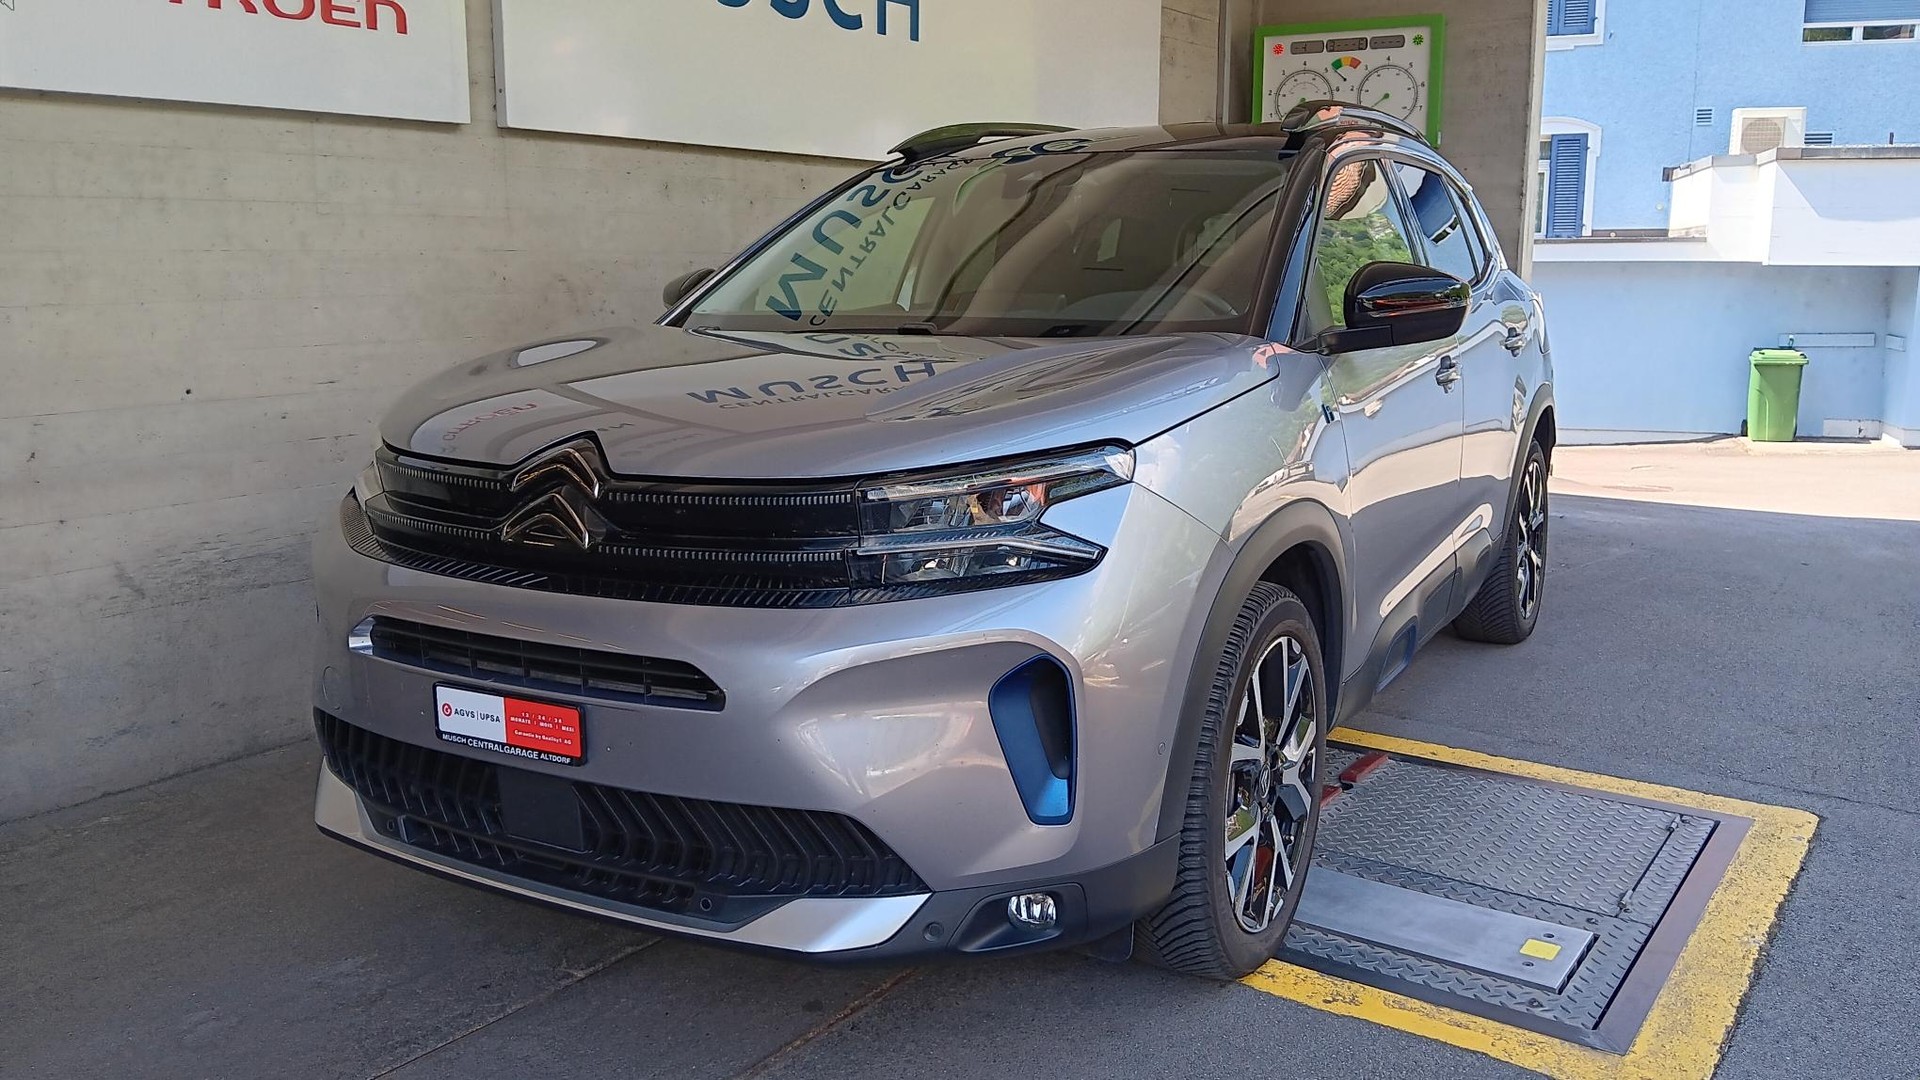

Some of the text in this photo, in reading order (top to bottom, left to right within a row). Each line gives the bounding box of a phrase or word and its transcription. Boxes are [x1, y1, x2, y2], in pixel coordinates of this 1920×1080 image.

[454, 708, 501, 723] AGVS UPSA
[442, 733, 571, 764] MUSCH CENTRALGARAGE ALTDORF
